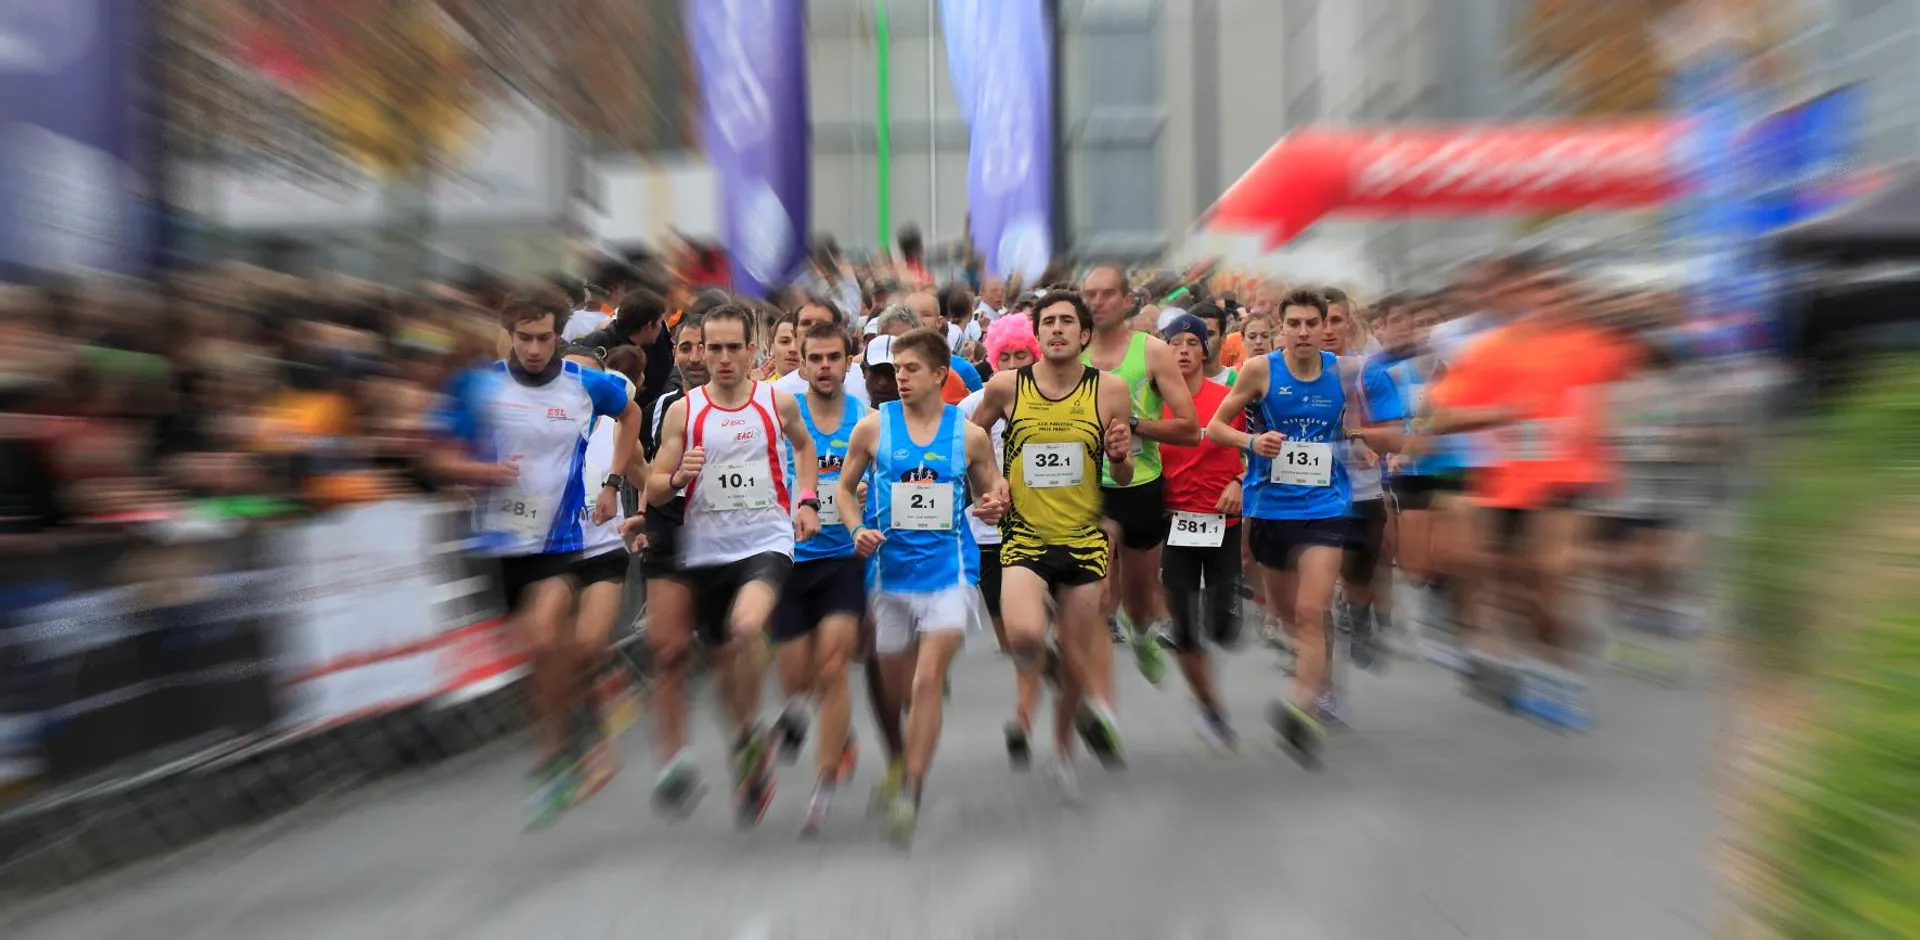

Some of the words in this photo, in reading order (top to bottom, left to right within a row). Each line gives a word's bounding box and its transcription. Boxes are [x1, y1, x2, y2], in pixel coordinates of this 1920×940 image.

[1035, 453, 1070, 467] 32.1
[1286, 451, 1319, 467] 13.1
[718, 474, 755, 489] 10.1
[501, 499, 537, 519] 28.1
[911, 494, 935, 509] 2.1
[1177, 519, 1219, 534] 581.1
